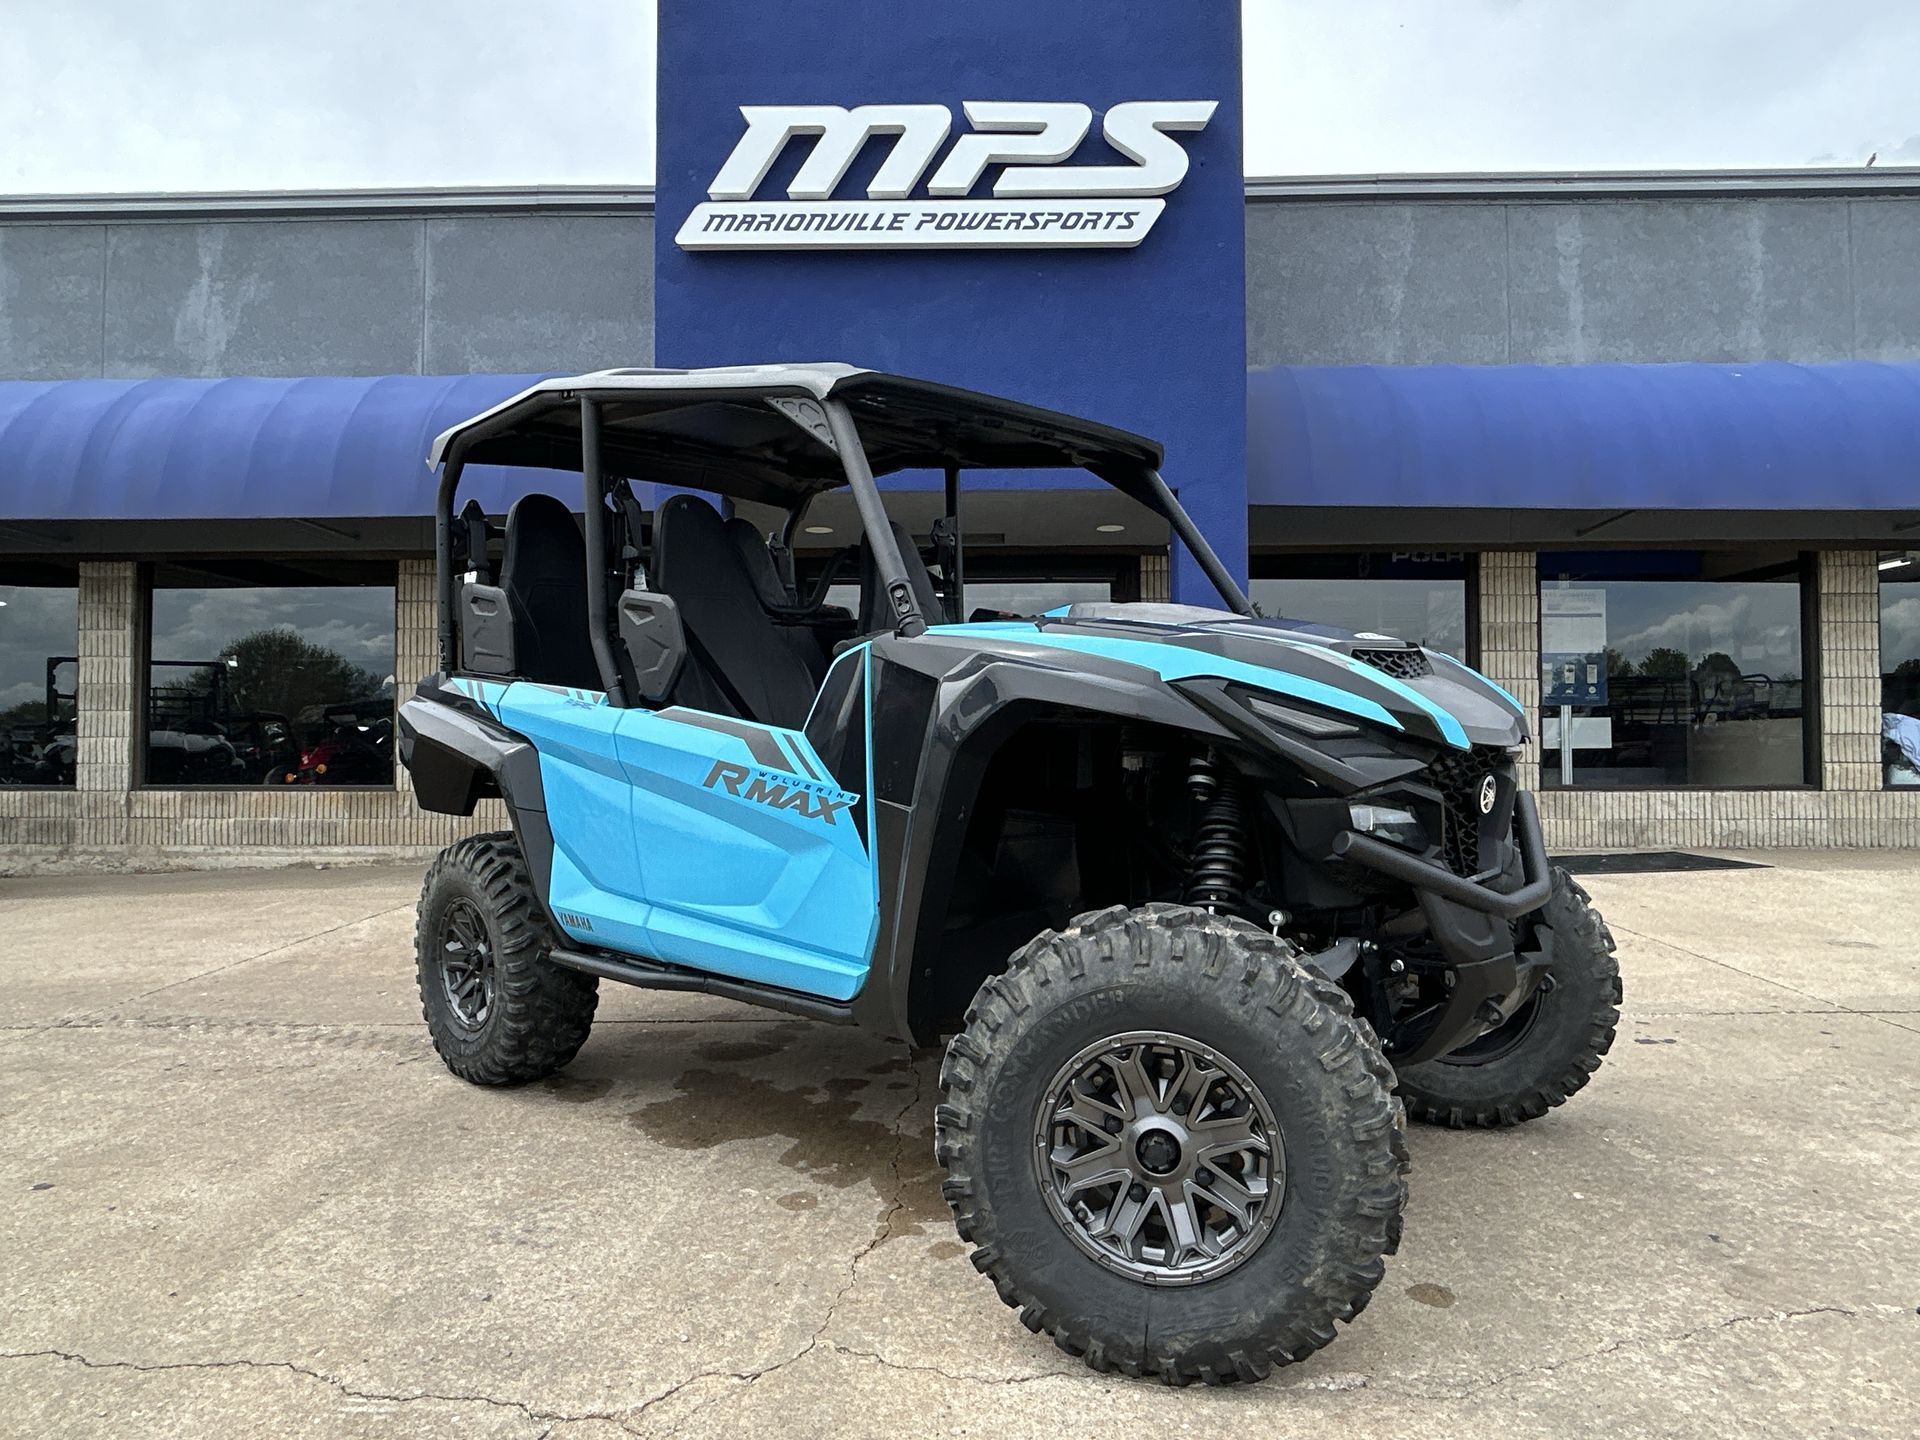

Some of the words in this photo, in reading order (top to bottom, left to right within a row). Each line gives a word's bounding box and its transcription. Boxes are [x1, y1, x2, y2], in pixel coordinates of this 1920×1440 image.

[707, 101, 1219, 200] MPS
[702, 213, 911, 232] MARIONVILLE
[914, 211, 1141, 231] POWERSPORTS
[702, 759, 850, 826] RMAX
[758, 771, 857, 802] WOLVERINE
[558, 911, 593, 932] YAMAHA
